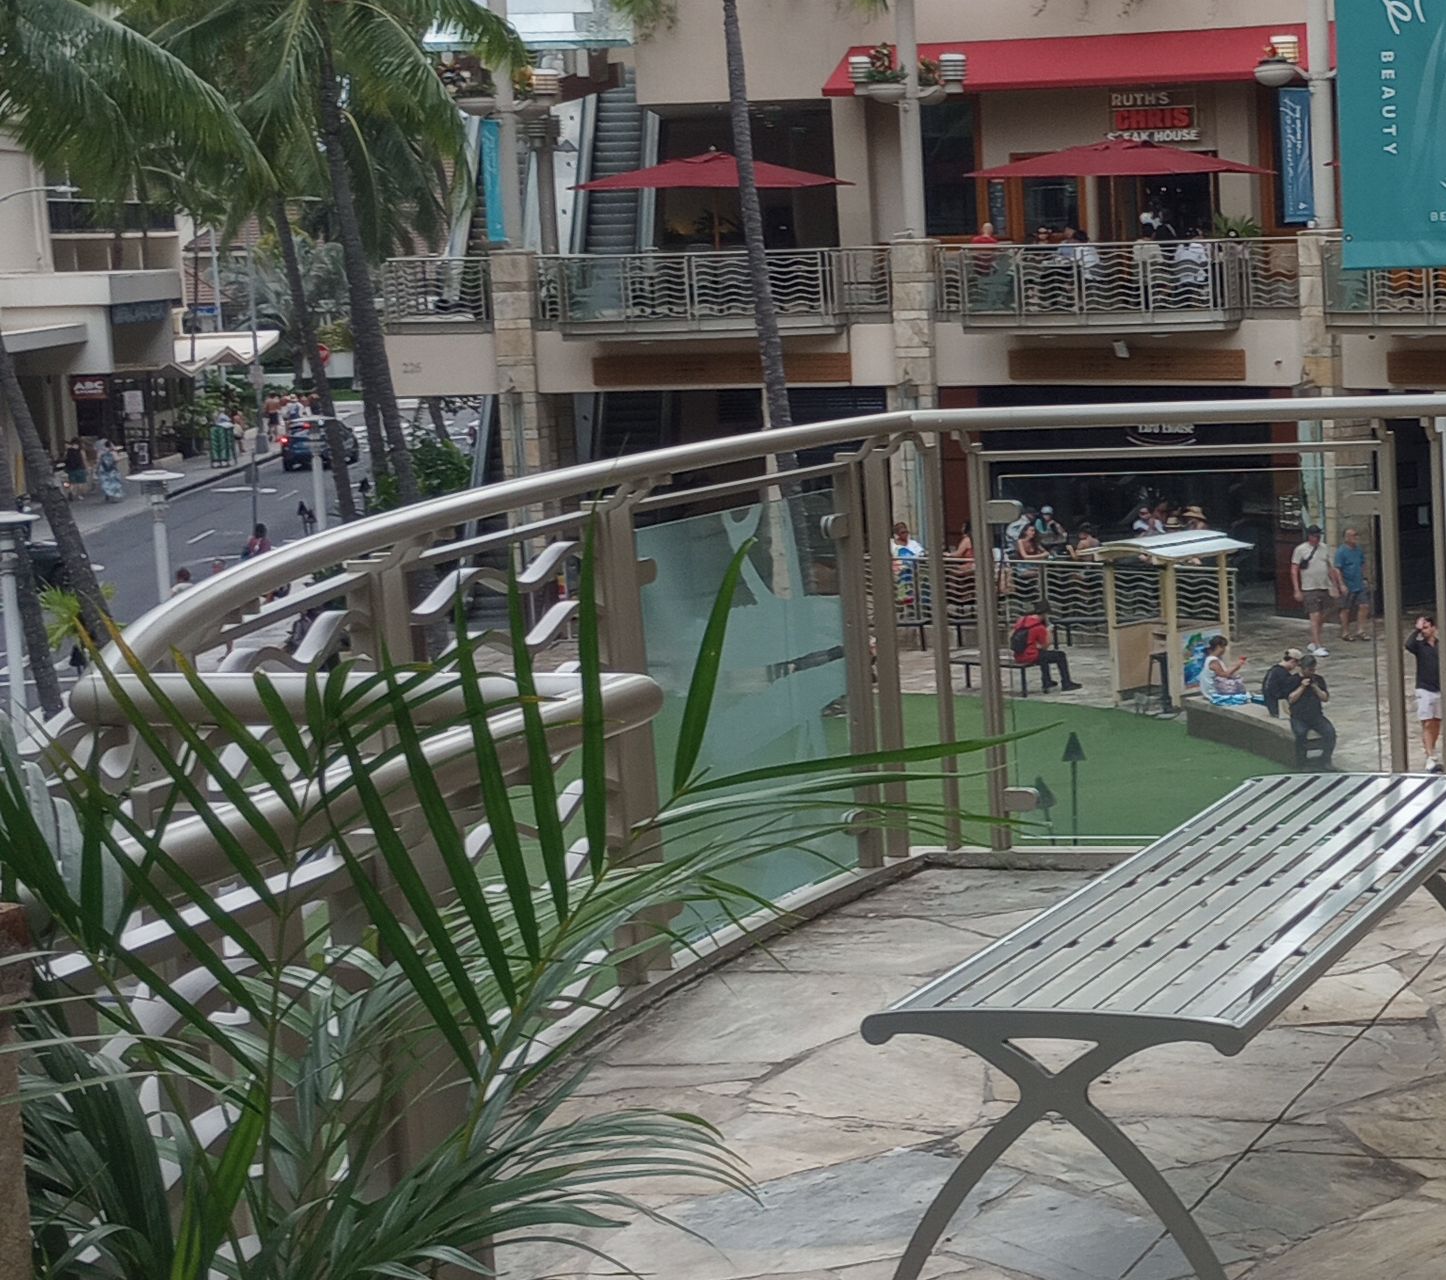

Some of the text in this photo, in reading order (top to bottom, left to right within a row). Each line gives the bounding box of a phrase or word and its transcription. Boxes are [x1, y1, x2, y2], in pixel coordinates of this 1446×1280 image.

[1380, 51, 1398, 155] BEAUTY
[1115, 107, 1191, 130] CHRIS
[1153, 129, 1201, 141] HOUSE
[73, 380, 104, 390] ABC
